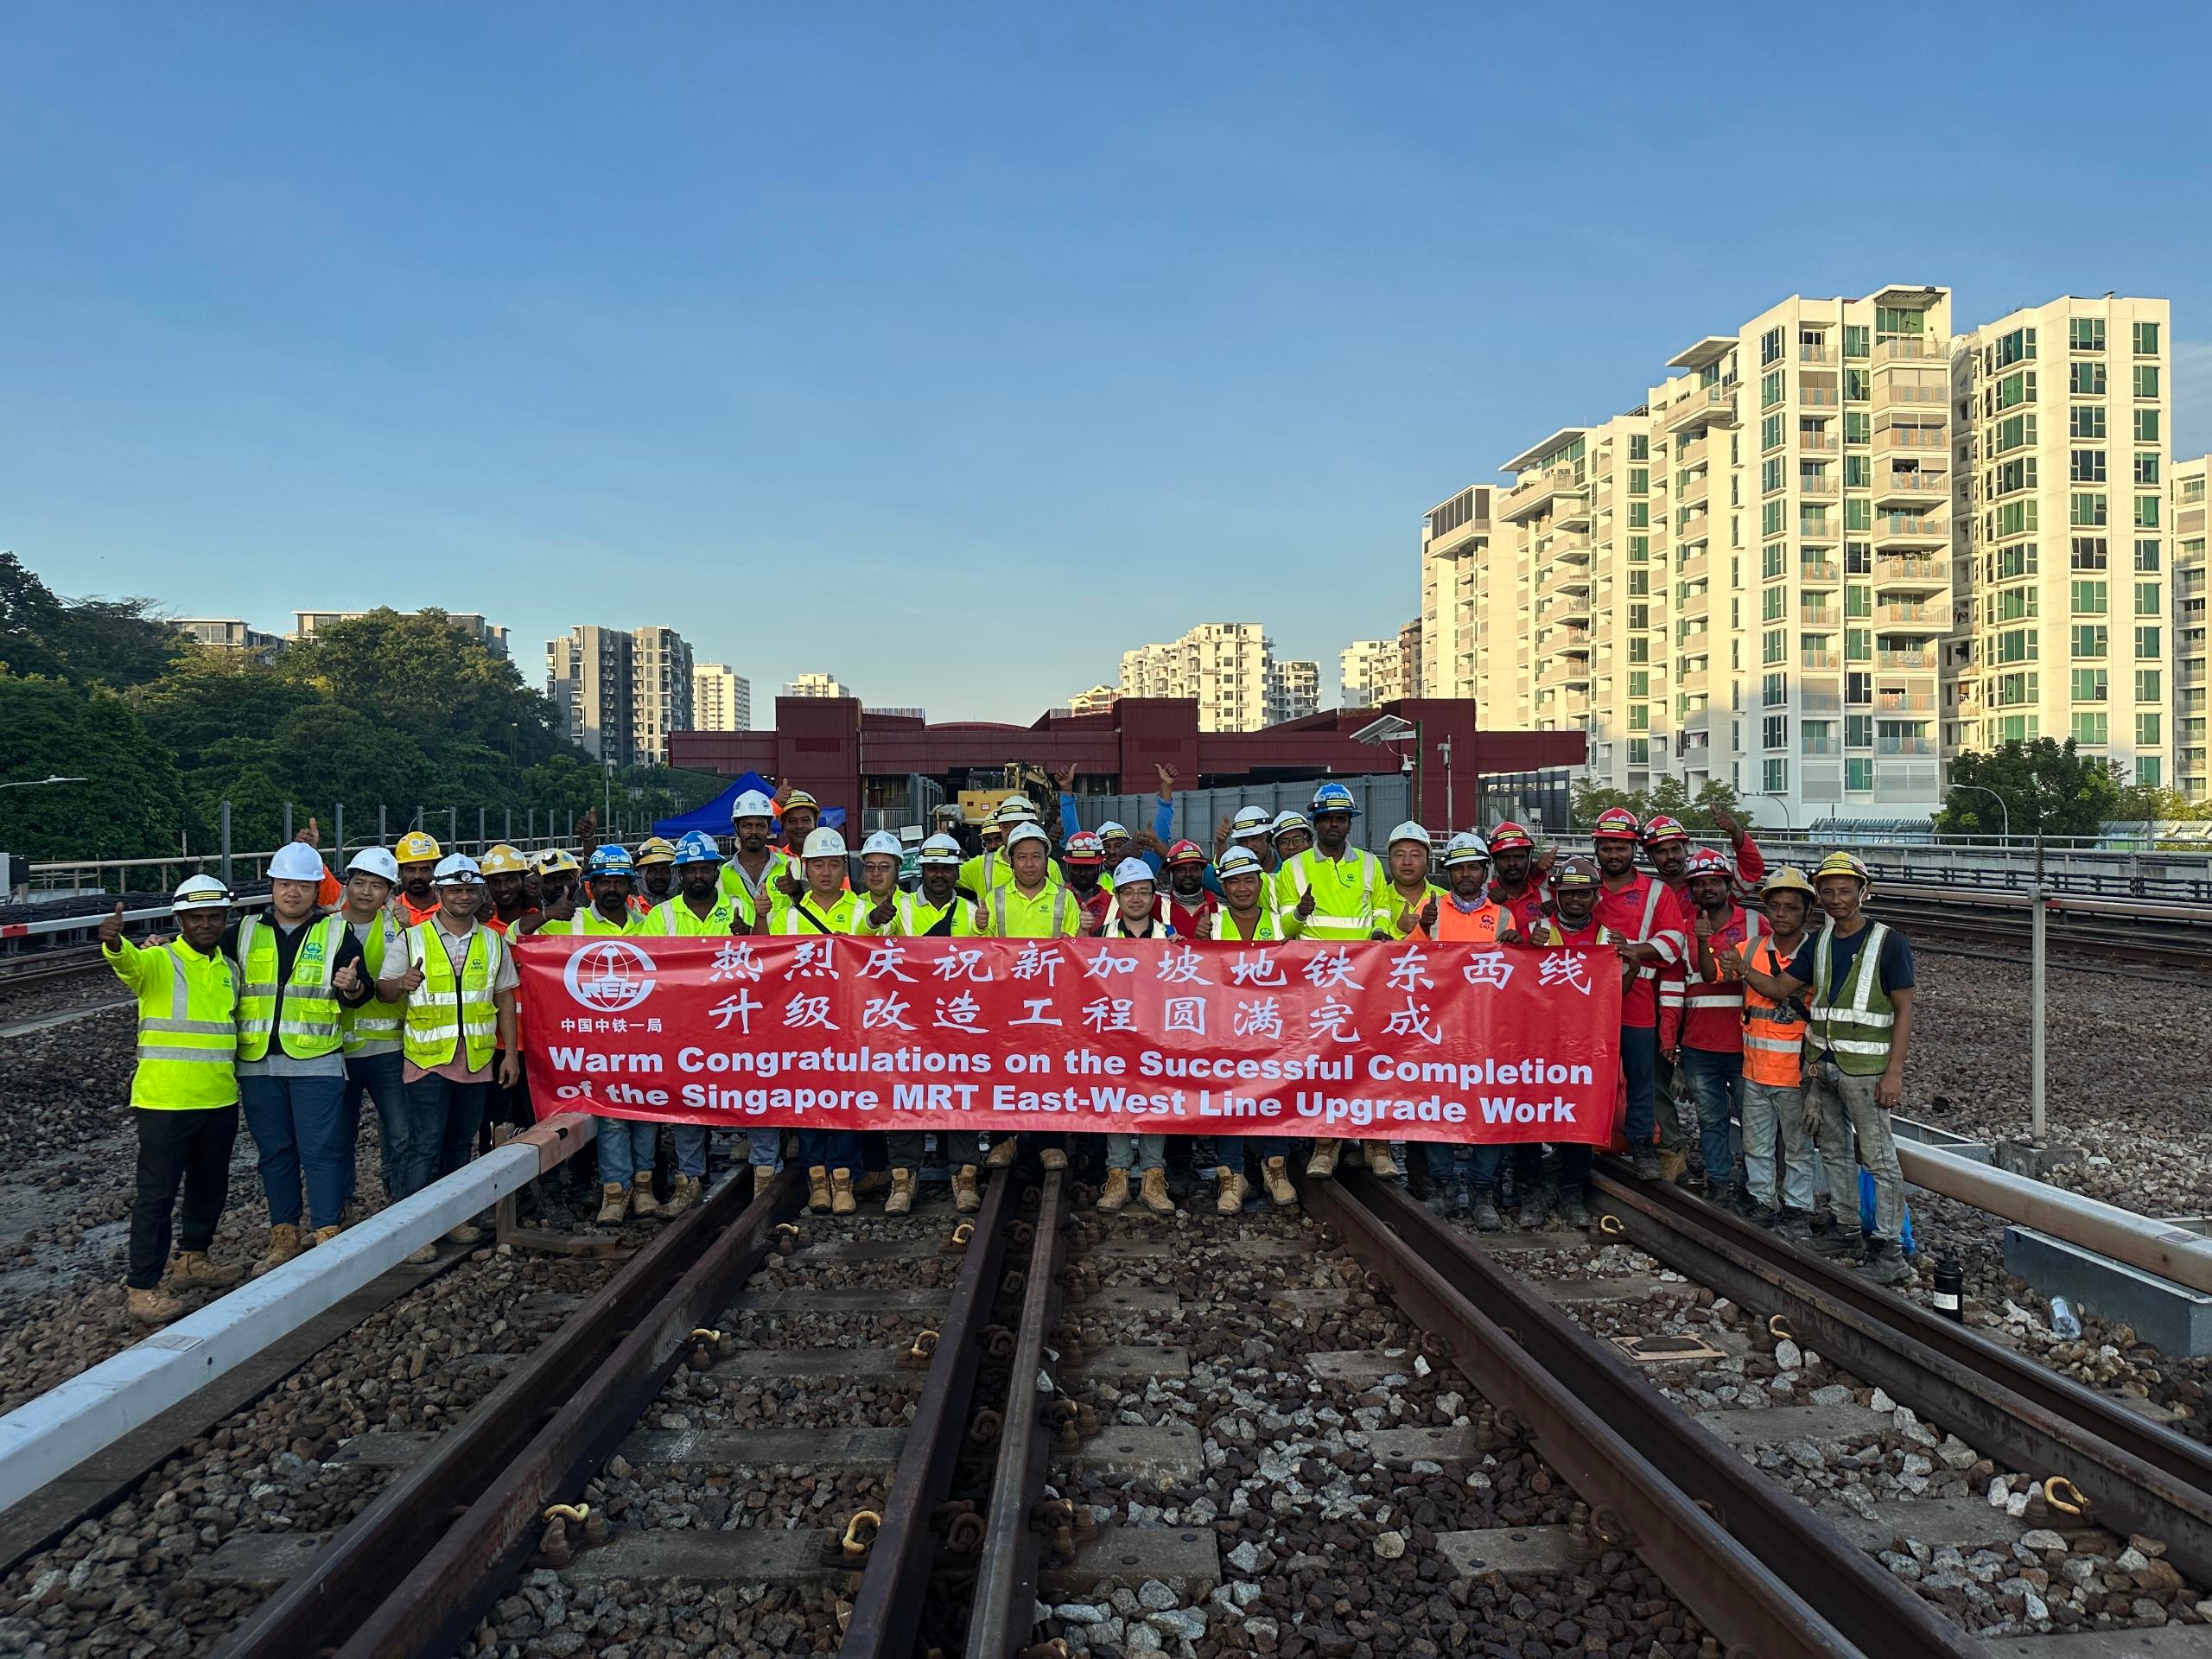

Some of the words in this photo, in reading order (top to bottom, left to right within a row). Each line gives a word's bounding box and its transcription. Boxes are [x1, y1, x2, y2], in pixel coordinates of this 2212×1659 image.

[302, 953, 323, 962] CRFG
[709, 939, 1592, 995] 热烈庆祝新加坡地铁东西线
[561, 1017, 663, 1033] 中国中铁一局
[708, 988, 1442, 1046] 升级改造工程圆满完成
[548, 1046, 663, 1073] Warm
[677, 1046, 993, 1077] Congratulations
[1004, 1053, 1051, 1074] on
[1064, 1048, 1126, 1075] the
[1139, 1051, 1354, 1081] Successful
[1368, 1054, 1592, 1090] Completion
[556, 1080, 593, 1100] of
[605, 1084, 670, 1107] the
[682, 1084, 880, 1116] Singapore
[893, 1084, 979, 1110] MRT
[993, 1084, 1186, 1116] East-West
[1199, 1090, 1282, 1116] Line
[1296, 1091, 1467, 1126] Upgrade
[1478, 1096, 1577, 1124] Work
